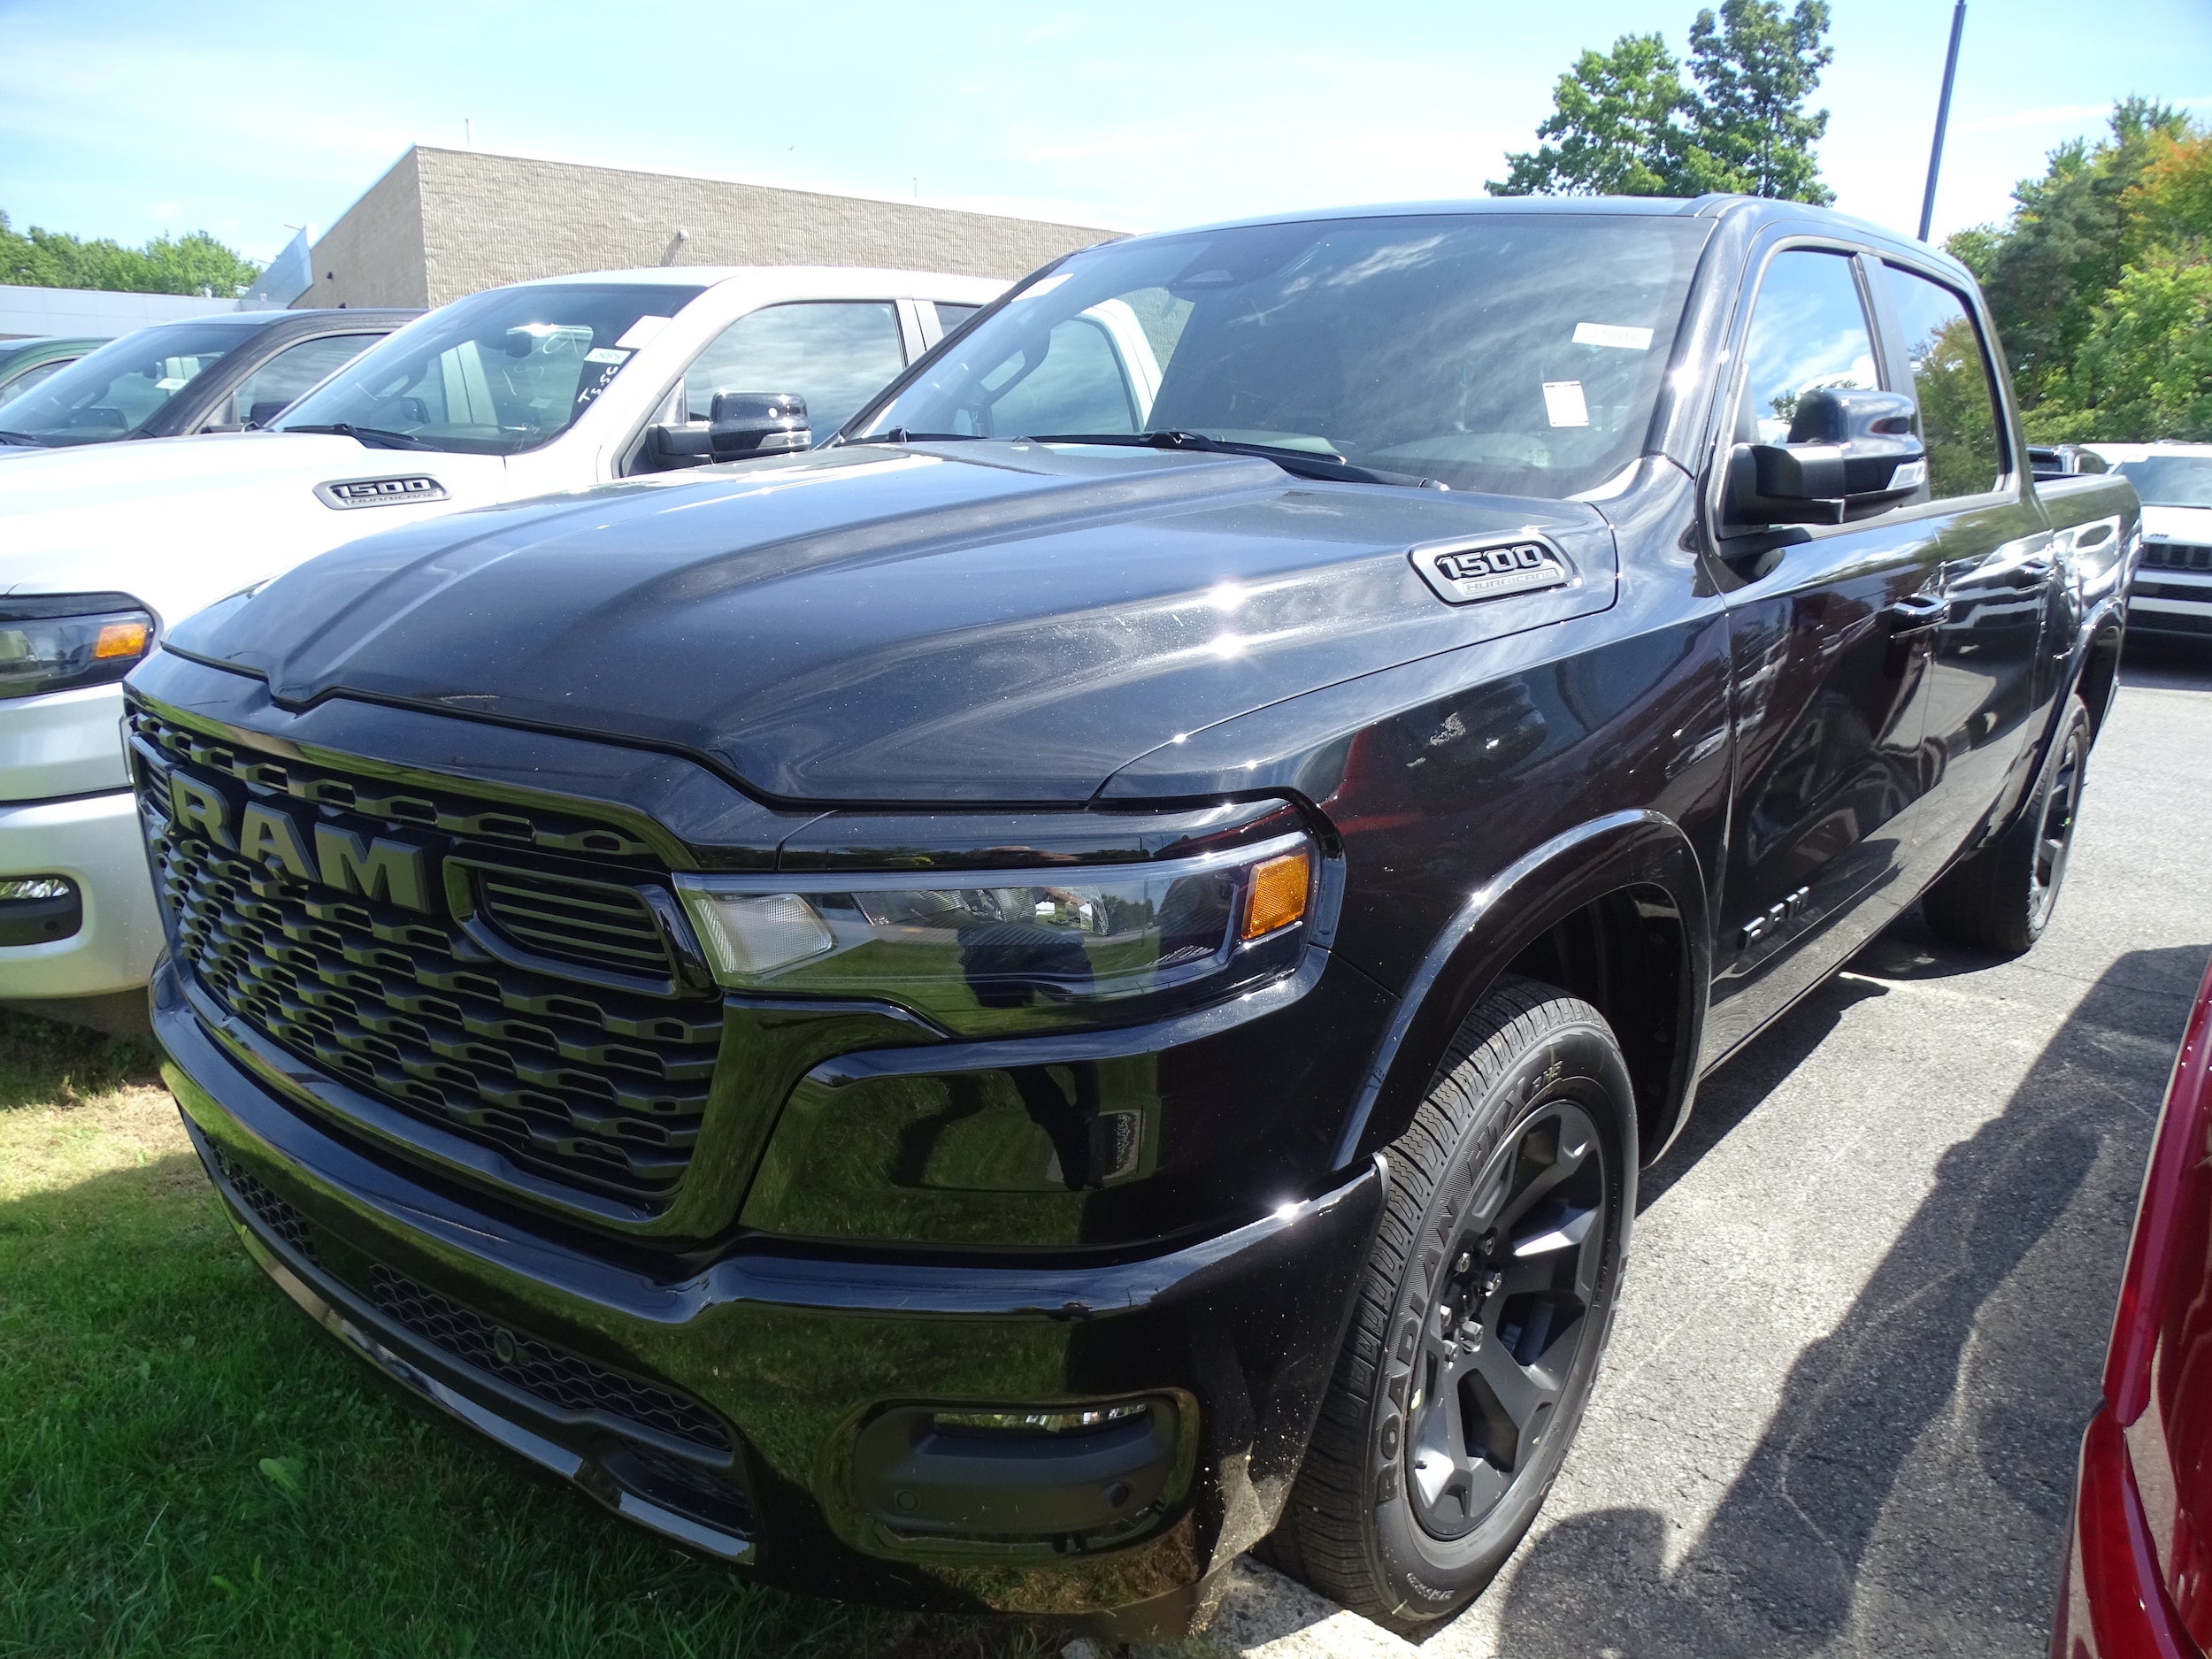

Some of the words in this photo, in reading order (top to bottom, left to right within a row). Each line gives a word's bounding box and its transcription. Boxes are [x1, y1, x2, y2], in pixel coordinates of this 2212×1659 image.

[333, 479, 431, 498] 1500
[1437, 544, 1545, 579] 1500
[1466, 570, 1555, 592] HURRICANE
[171, 768, 430, 915] RAM
[1739, 886, 1809, 949] RAM
[1377, 1194, 1460, 1504] ROADIAN
[1467, 1076, 1527, 1182] HTX
